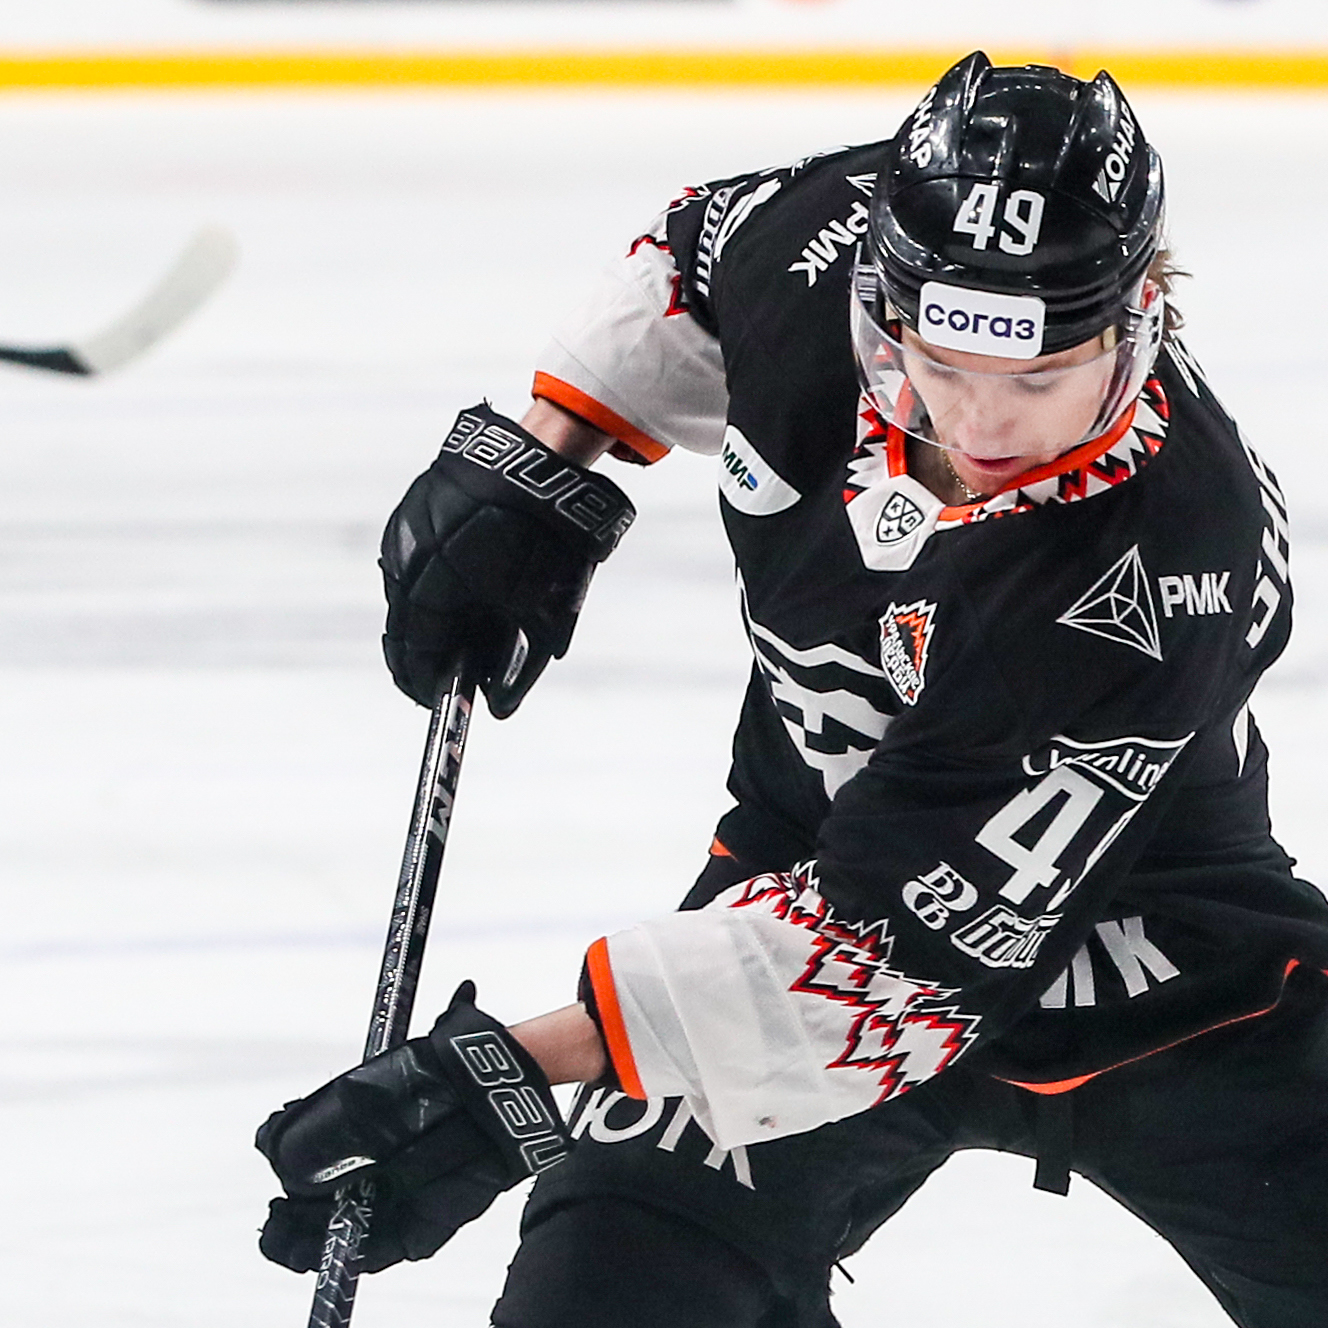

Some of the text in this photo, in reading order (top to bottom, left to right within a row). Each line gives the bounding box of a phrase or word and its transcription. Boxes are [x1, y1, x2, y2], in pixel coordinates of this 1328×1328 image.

[953, 182, 1046, 256] 49
[924, 303, 1036, 340] согаз
[975, 765, 1142, 912] 4
